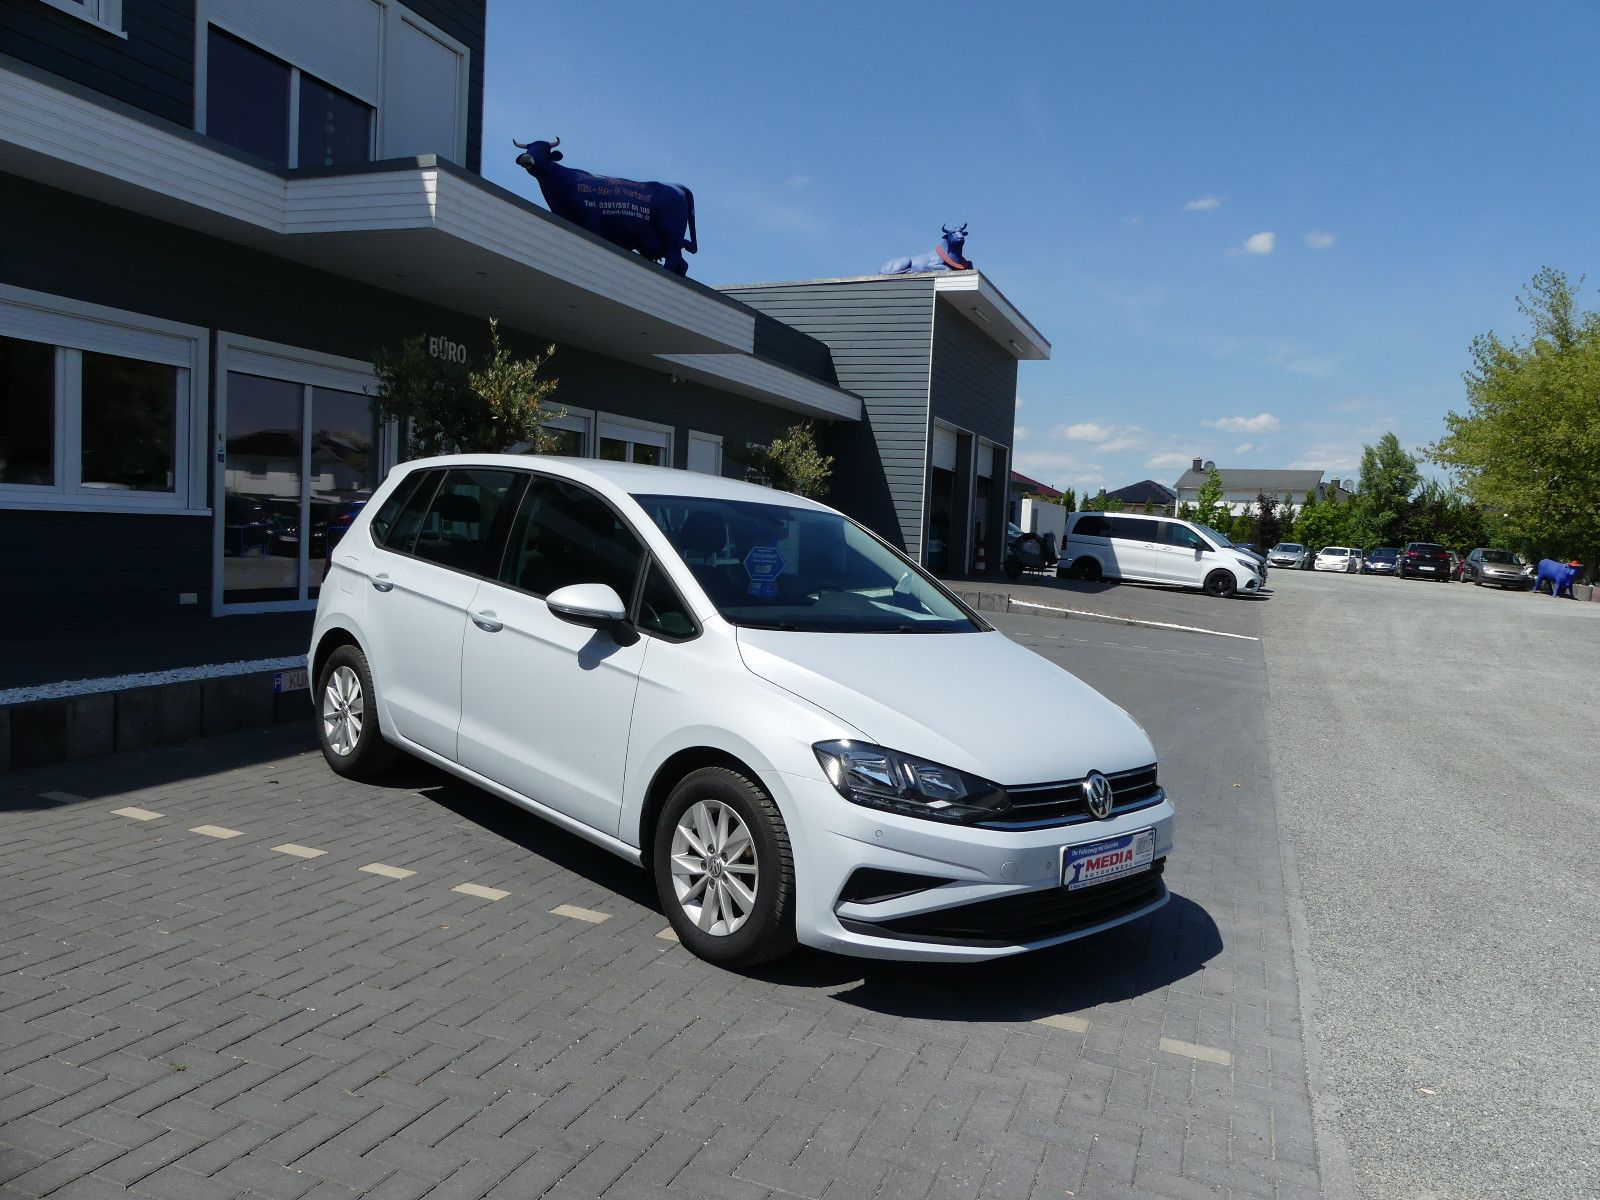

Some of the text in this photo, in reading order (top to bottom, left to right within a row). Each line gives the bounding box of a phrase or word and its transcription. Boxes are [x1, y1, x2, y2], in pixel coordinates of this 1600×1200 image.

[584, 200, 597, 208] Tel.
[430, 336, 467, 364] BÜRO
[1085, 849, 1133, 872] MEDIA
